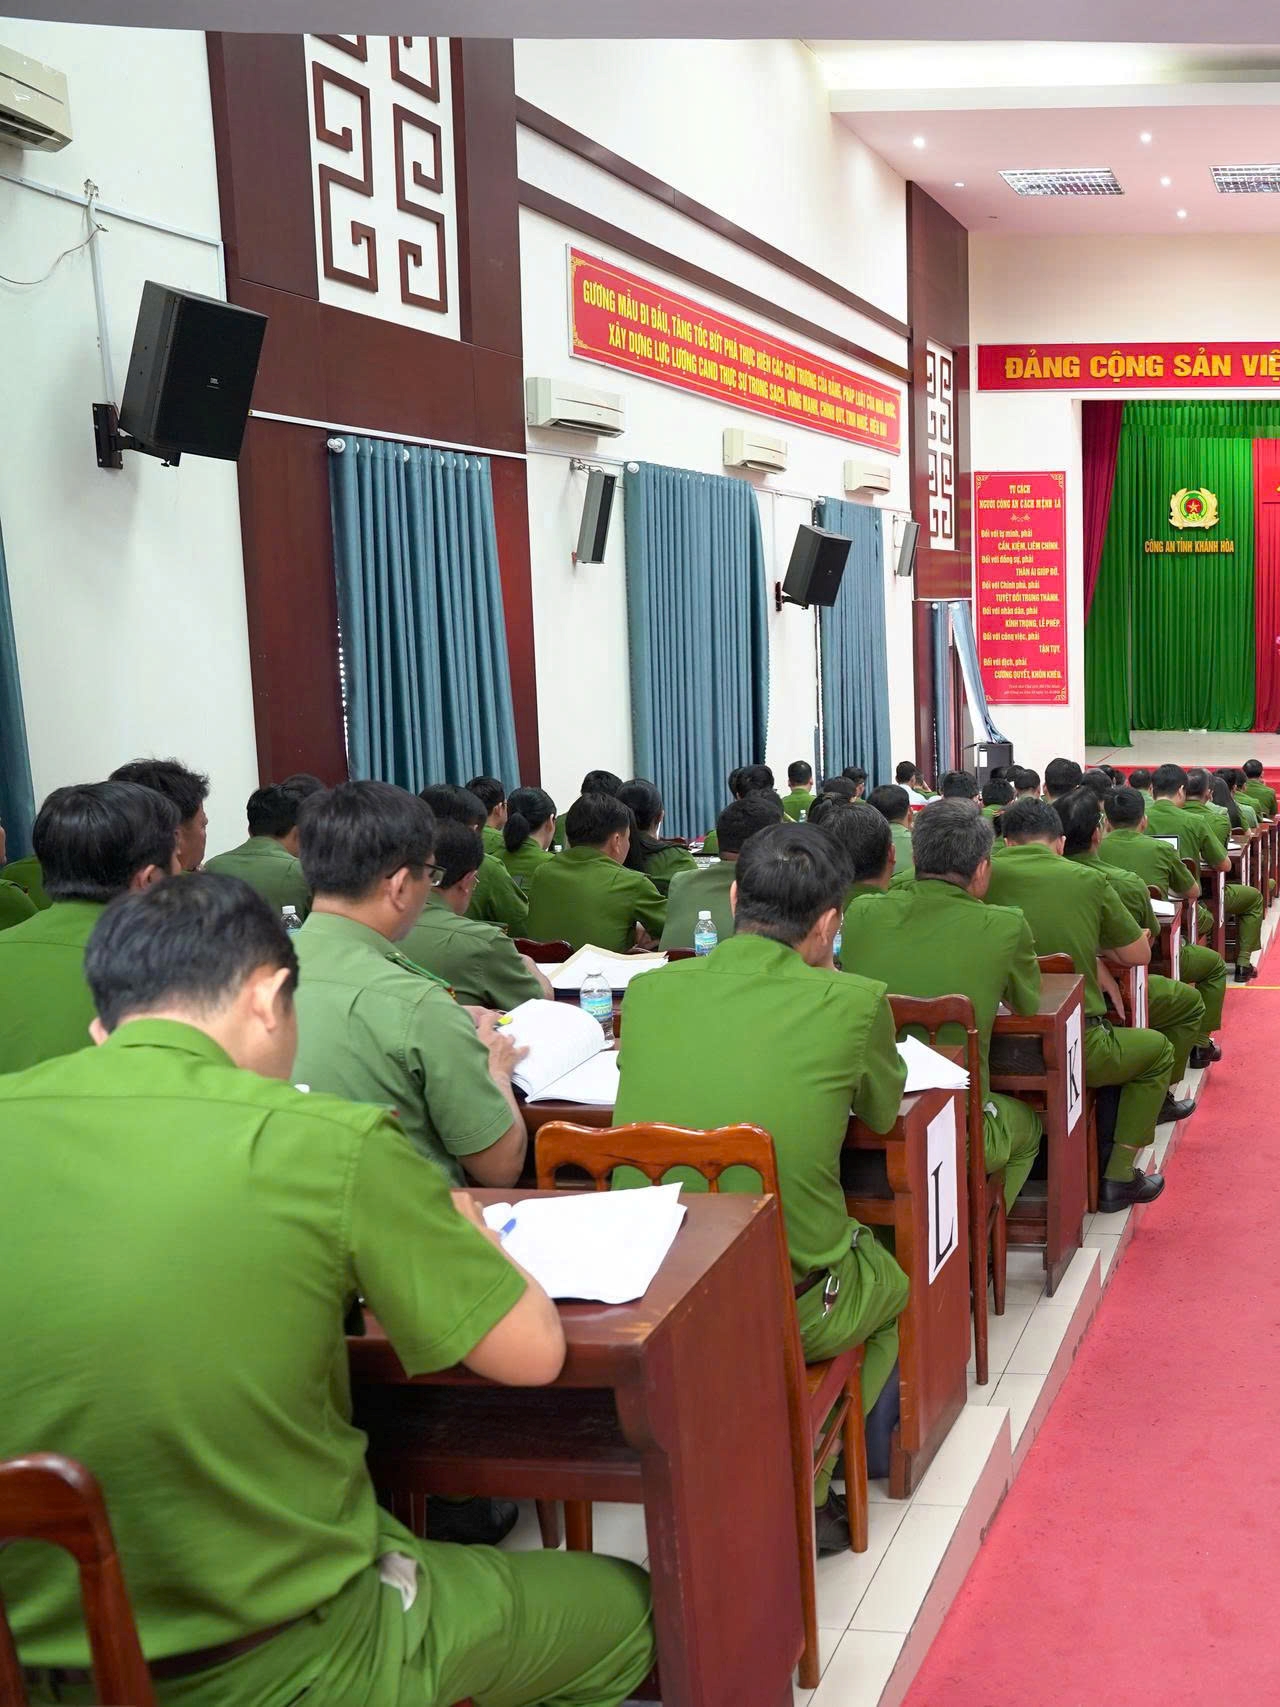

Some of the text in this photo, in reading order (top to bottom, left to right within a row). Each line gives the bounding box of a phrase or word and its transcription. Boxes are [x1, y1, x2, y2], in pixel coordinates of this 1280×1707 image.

[583, 280, 615, 312] GƯƠNG
[618, 289, 638, 321] MẪU
[640, 303, 649, 325] ĐI
[651, 304, 670, 336] ĐẦU,
[672, 314, 692, 342] TĂNG
[694, 322, 708, 348] TỐC
[609, 321, 626, 349] XÂY
[629, 331, 652, 359] DỰNG
[655, 340, 669, 368] LỰC
[672, 346, 696, 374] LƯỢNG
[1005, 349, 1080, 379] ĐẢNG
[1090, 350, 1163, 382] CỘNG
[1173, 347, 1231, 378] SẢN
[1145, 537, 1234, 552] CÔNG AN TỈNH KHÁNH HÒA
[1066, 1038, 1080, 1113] K
[931, 1161, 954, 1272] L
